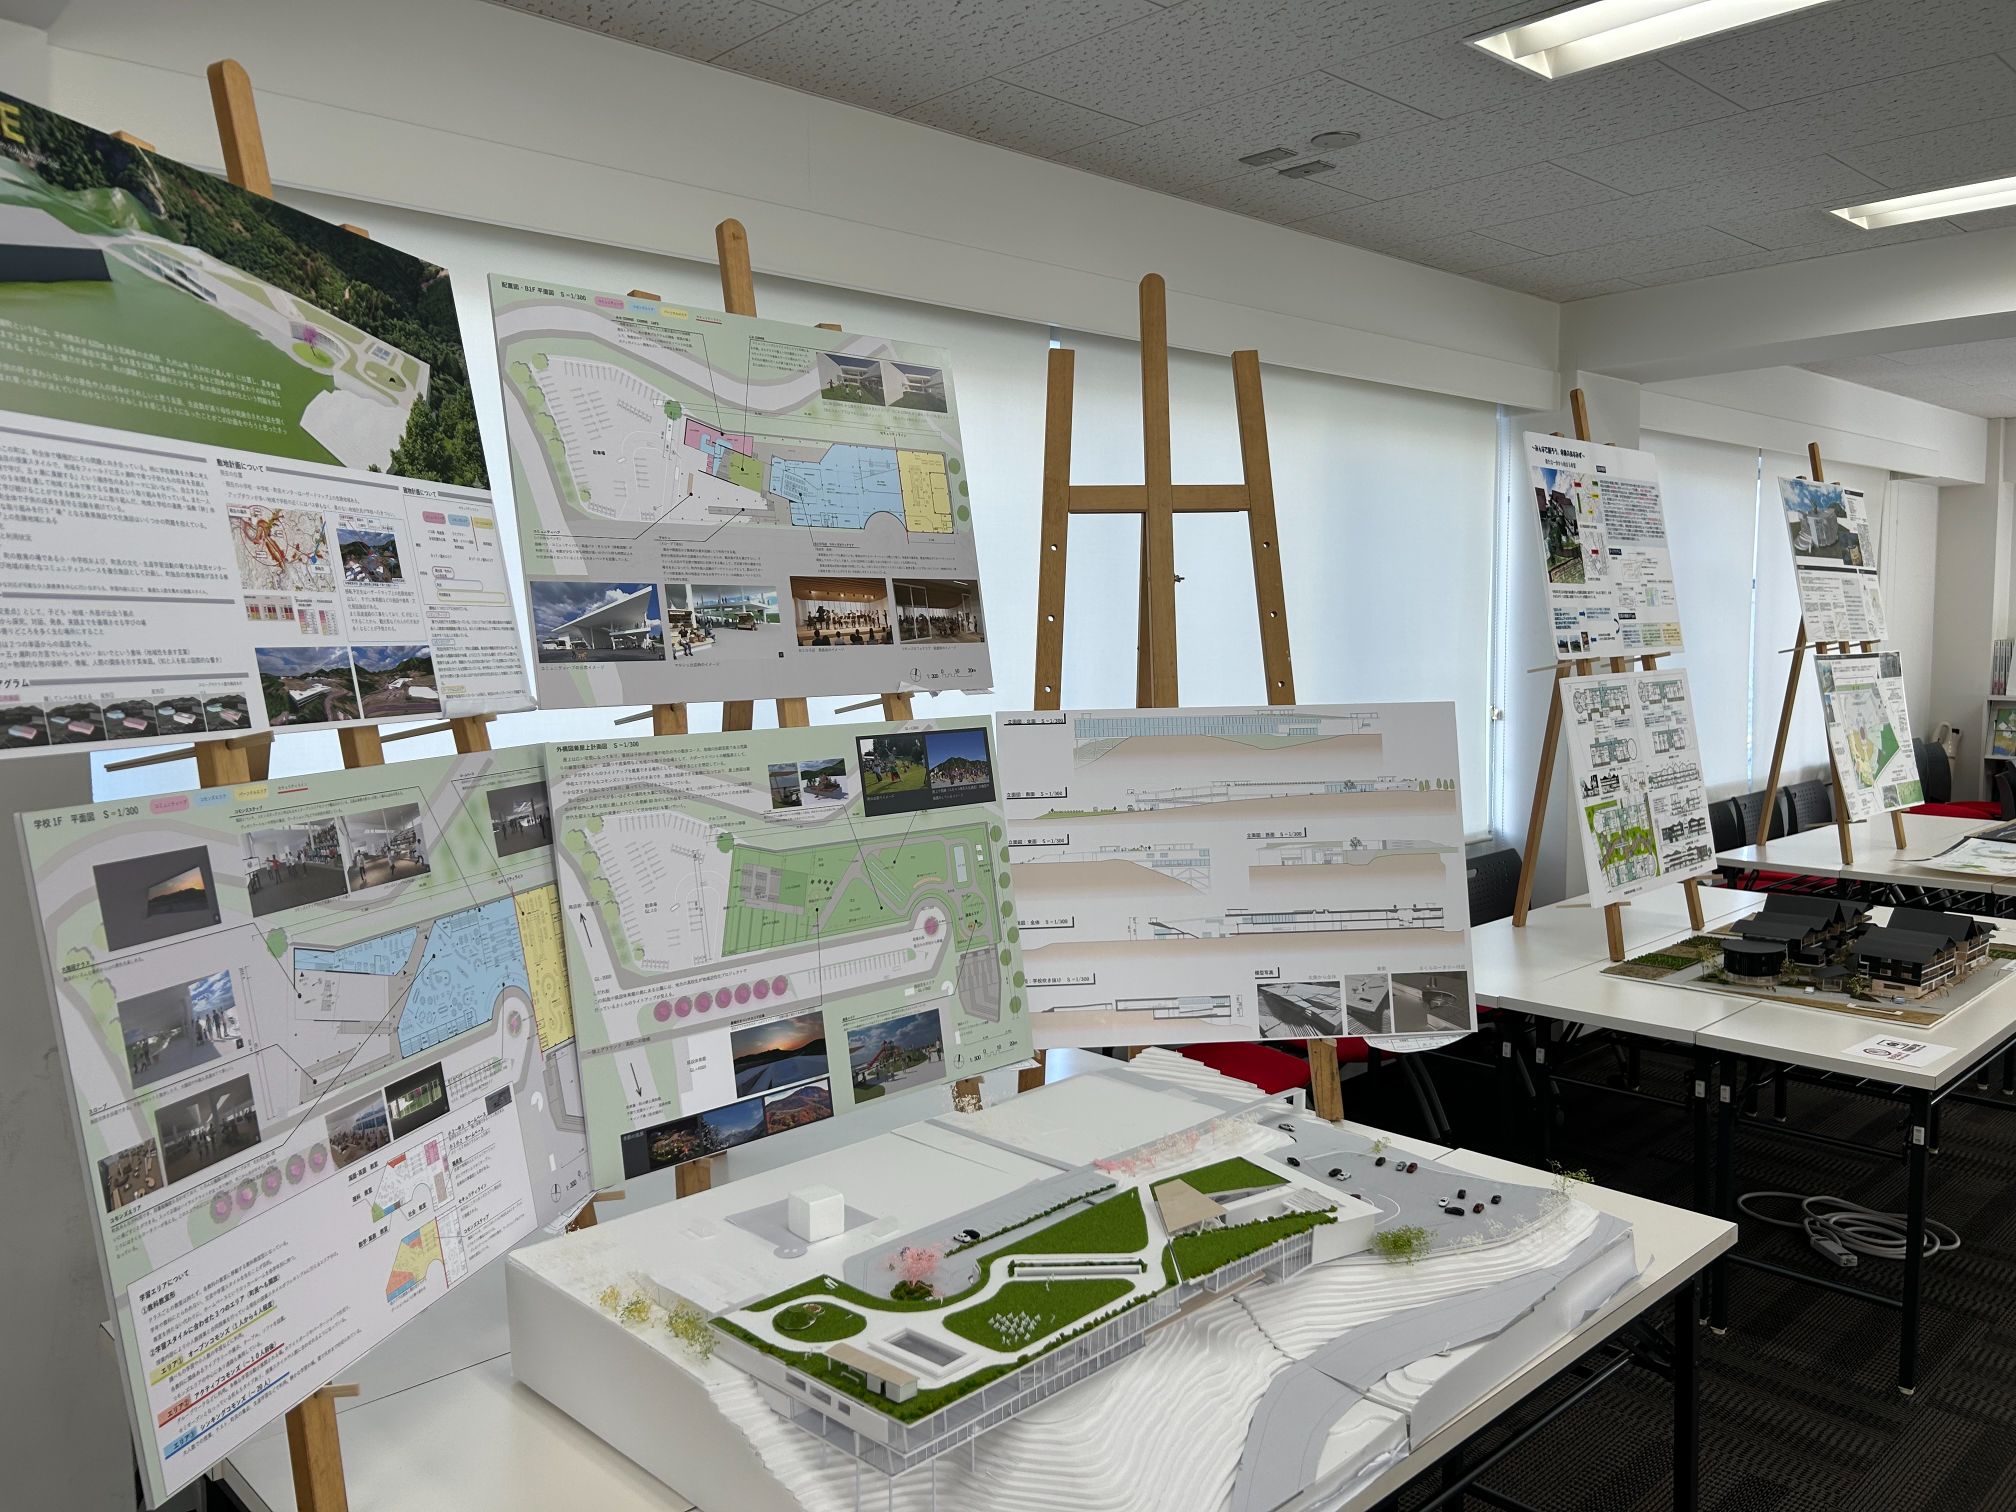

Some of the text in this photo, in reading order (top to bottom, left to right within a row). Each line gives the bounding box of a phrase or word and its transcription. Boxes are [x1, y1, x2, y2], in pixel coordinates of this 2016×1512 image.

[70, 811, 96, 824] 平面図
[139, 1269, 190, 1302] 学習エリアについて
